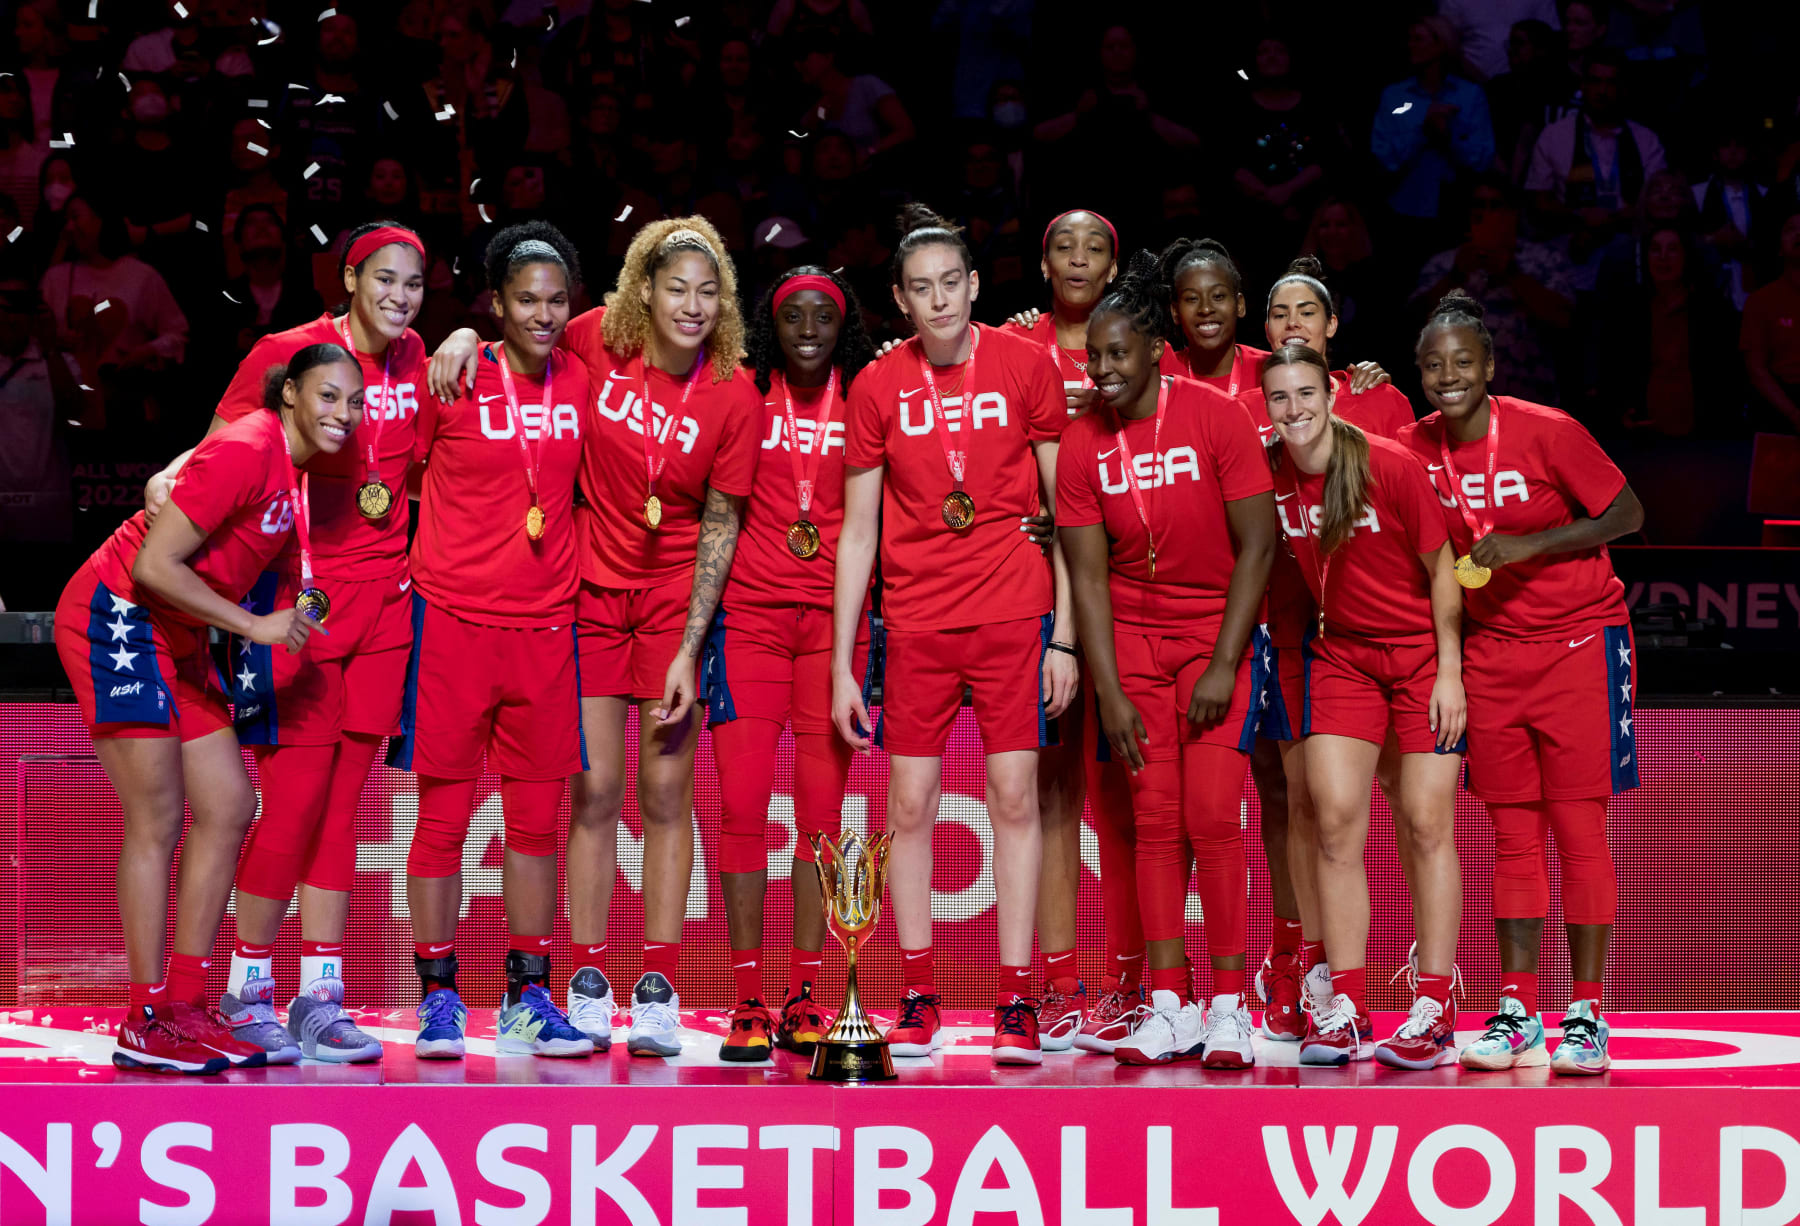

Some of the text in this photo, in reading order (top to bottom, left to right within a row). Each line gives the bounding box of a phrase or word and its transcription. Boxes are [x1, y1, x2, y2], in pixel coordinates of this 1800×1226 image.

[365, 382, 419, 421] SA
[900, 391, 1008, 436] USA
[925, 370, 943, 419] AUSTRALIA 2022
[479, 403, 579, 440] USA
[597, 380, 699, 454] USA
[788, 414, 798, 449] AUSTRALIA
[1099, 445, 1200, 495] USA
[1429, 470, 1530, 509] USA
[77, 484, 145, 507] 2022
[110, 681, 144, 697] USA
[238, 704, 261, 719] USA
[270, 1123, 1219, 1226] BASKETBALL
[1261, 1123, 1800, 1226] WORLD
